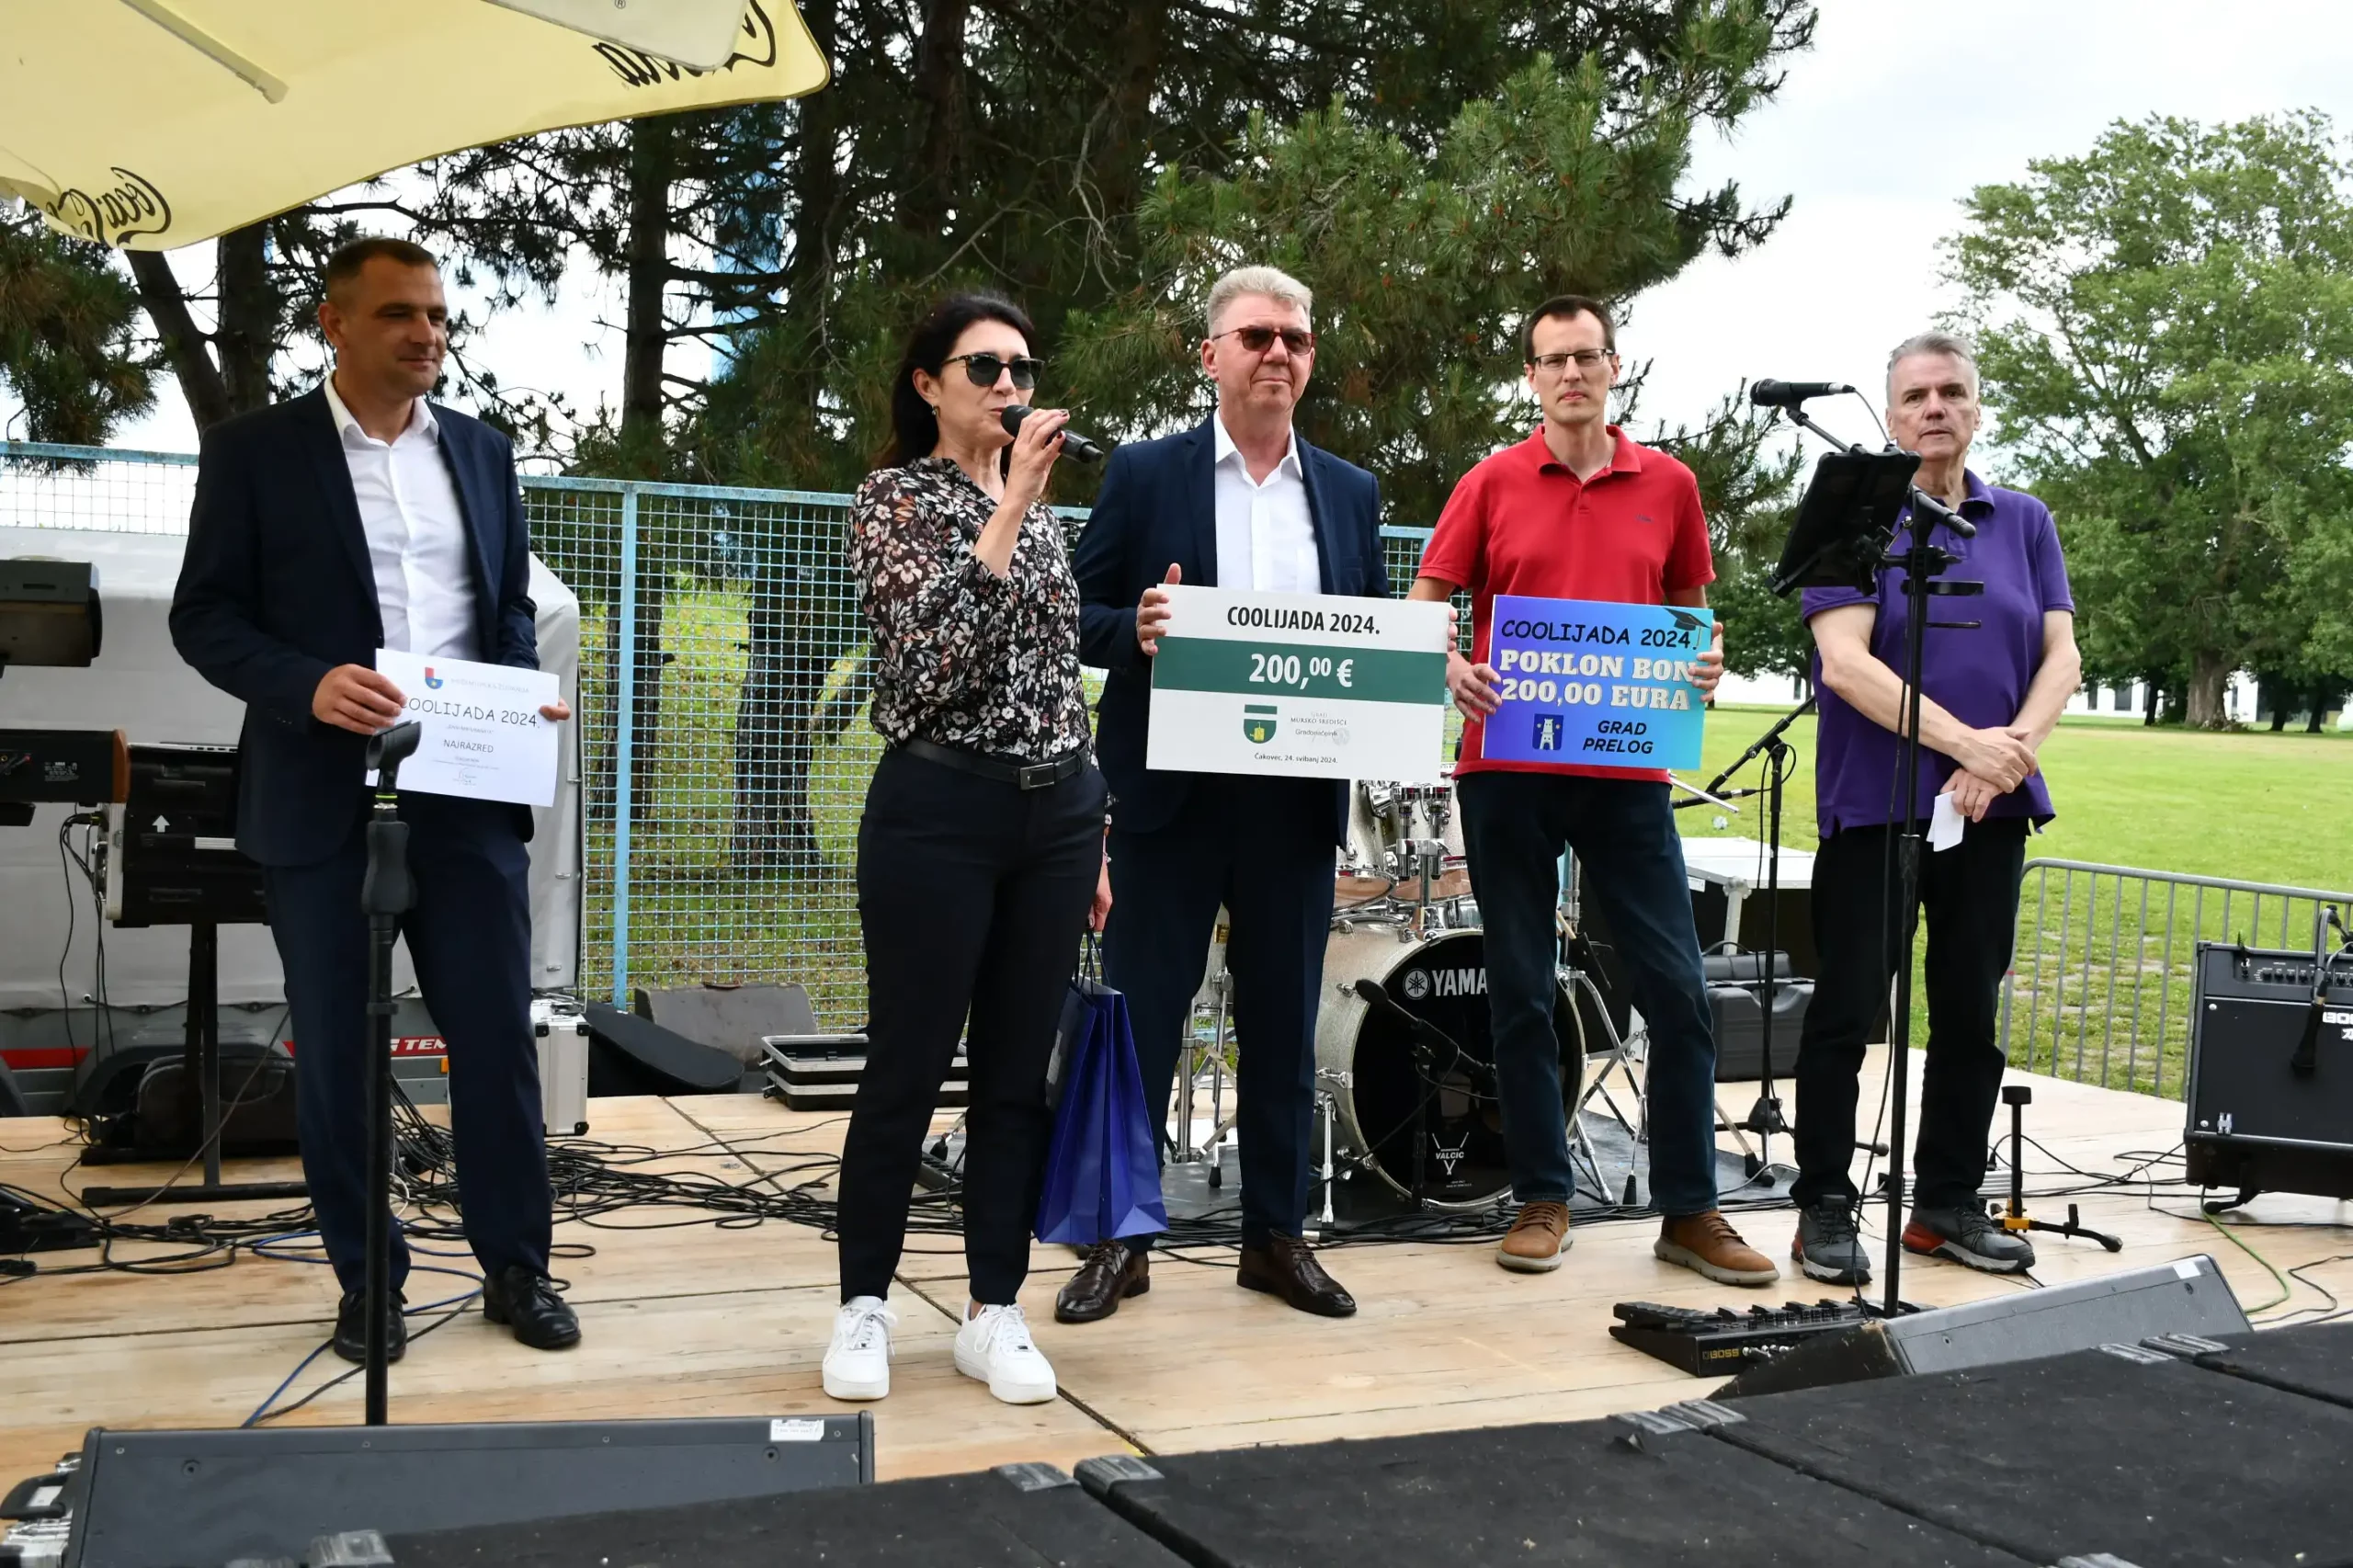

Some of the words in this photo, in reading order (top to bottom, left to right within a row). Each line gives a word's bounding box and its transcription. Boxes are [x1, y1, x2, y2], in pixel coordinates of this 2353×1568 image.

[1226, 606, 1325, 631] COOLIJADA
[1329, 613, 1381, 635] 2024.
[1501, 619, 1631, 645] COOLIJADA
[1248, 653, 1332, 690] 200,00
[1336, 659, 1354, 688] €
[1499, 649, 1624, 679] POKLON
[1631, 657, 1696, 684] BON
[1500, 678, 1603, 707] 200,00
[1609, 685, 1690, 710] EURA
[501, 710, 540, 729] 2024.
[1597, 721, 1647, 735] GRAD
[443, 739, 494, 754] NAJRAZRED
[1582, 737, 1654, 755] PRELOG
[1254, 752, 1283, 762] Čakovec,
[1296, 755, 1319, 764] svibanj
[1431, 968, 1488, 996] YAMA
[2322, 1012, 2353, 1026] BO
[1436, 1152, 1465, 1160] VALCIC
[1710, 1347, 1740, 1359] BOSS
